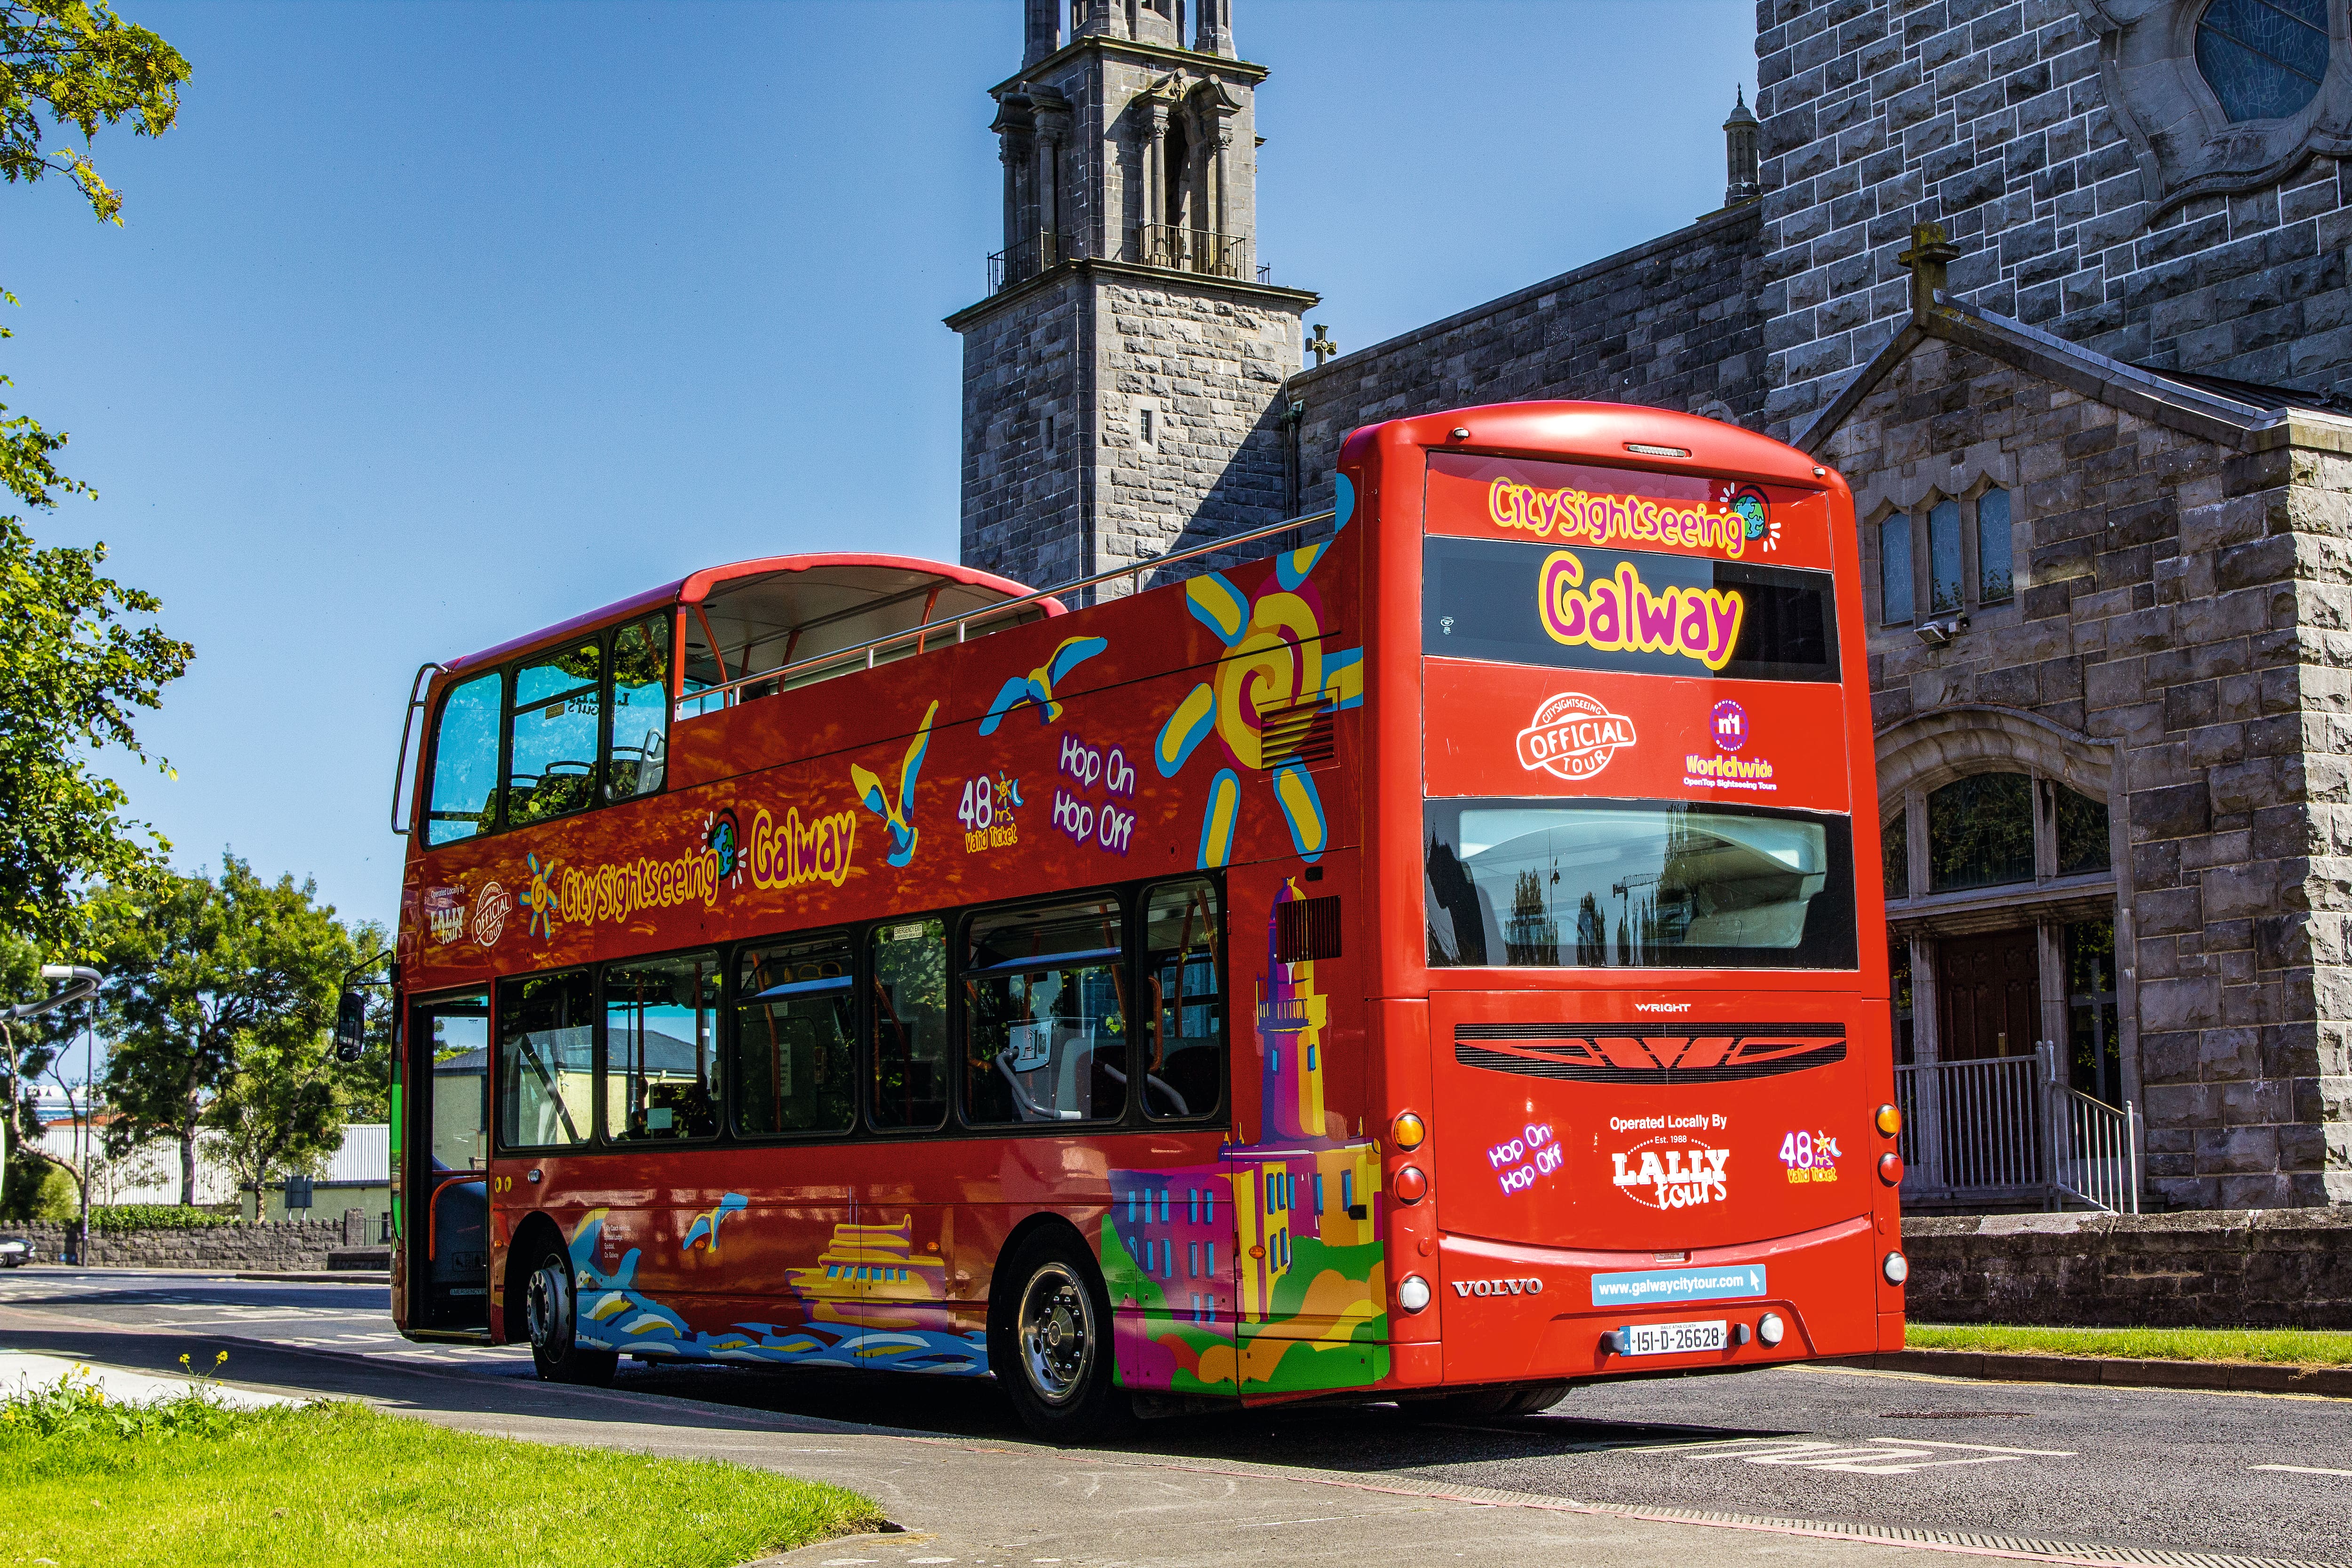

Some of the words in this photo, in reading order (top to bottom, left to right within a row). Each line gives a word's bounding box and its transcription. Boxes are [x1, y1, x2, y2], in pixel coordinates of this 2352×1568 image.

[1489, 477, 1745, 558] CitySightseeing
[1538, 550, 1744, 670] Galway
[1542, 698, 1601, 724] CITYSIGHTSEEING
[1530, 720, 1629, 759] OFFICIAL
[1060, 735, 1101, 787] Hop
[1106, 748, 1135, 796] On
[1563, 749, 1607, 773] TOUR
[1686, 755, 1773, 778] Worldwide
[1683, 777, 1716, 788] OpenTop
[1716, 779, 1757, 790] Sightseeing
[1757, 781, 1777, 790] Tours
[959, 776, 992, 830] 48
[994, 806, 1015, 823] hrs.
[1053, 790, 1094, 842] Hop
[1099, 804, 1136, 852] Off
[965, 828, 988, 854] Valid
[989, 822, 1018, 848] Ticket
[562, 847, 719, 926] CitySightseeing
[751, 806, 856, 890] Galway
[431, 887, 446, 898] Operated
[447, 885, 460, 895] Locally
[460, 884, 465, 894] By
[480, 886, 500, 908] CITYSIGHTSEEING
[430, 906, 465, 932] LALLY
[476, 896, 510, 935] OFFICIAL
[486, 920, 501, 941] TOUR
[895, 925, 914, 934] EMERGENCY
[1634, 1003, 1692, 1012] WRIGHT
[1610, 1116, 1664, 1133] Operated
[1668, 1114, 1709, 1130] Locally
[1712, 1114, 1727, 1130] By
[1488, 1139, 1524, 1168] Hop
[1525, 1125, 1551, 1147] On
[1670, 1135, 1687, 1143] 1988
[1780, 1131, 1813, 1168] 48
[1500, 1165, 1535, 1194] Hop
[1536, 1143, 1562, 1174] Off
[1612, 1149, 1730, 1186] LALLY
[1815, 1154, 1834, 1166] hrs.
[1787, 1167, 1810, 1183] Valid
[1811, 1166, 1837, 1182] Ticket
[1654, 1178, 1727, 1210] tours
[609, 1251, 619, 1260] Galway
[1452, 1277, 1543, 1298] VOLVO
[1599, 1276, 1744, 1297] www.galwaycitytour.com
[1637, 1327, 1719, 1352] 151-D-26628
